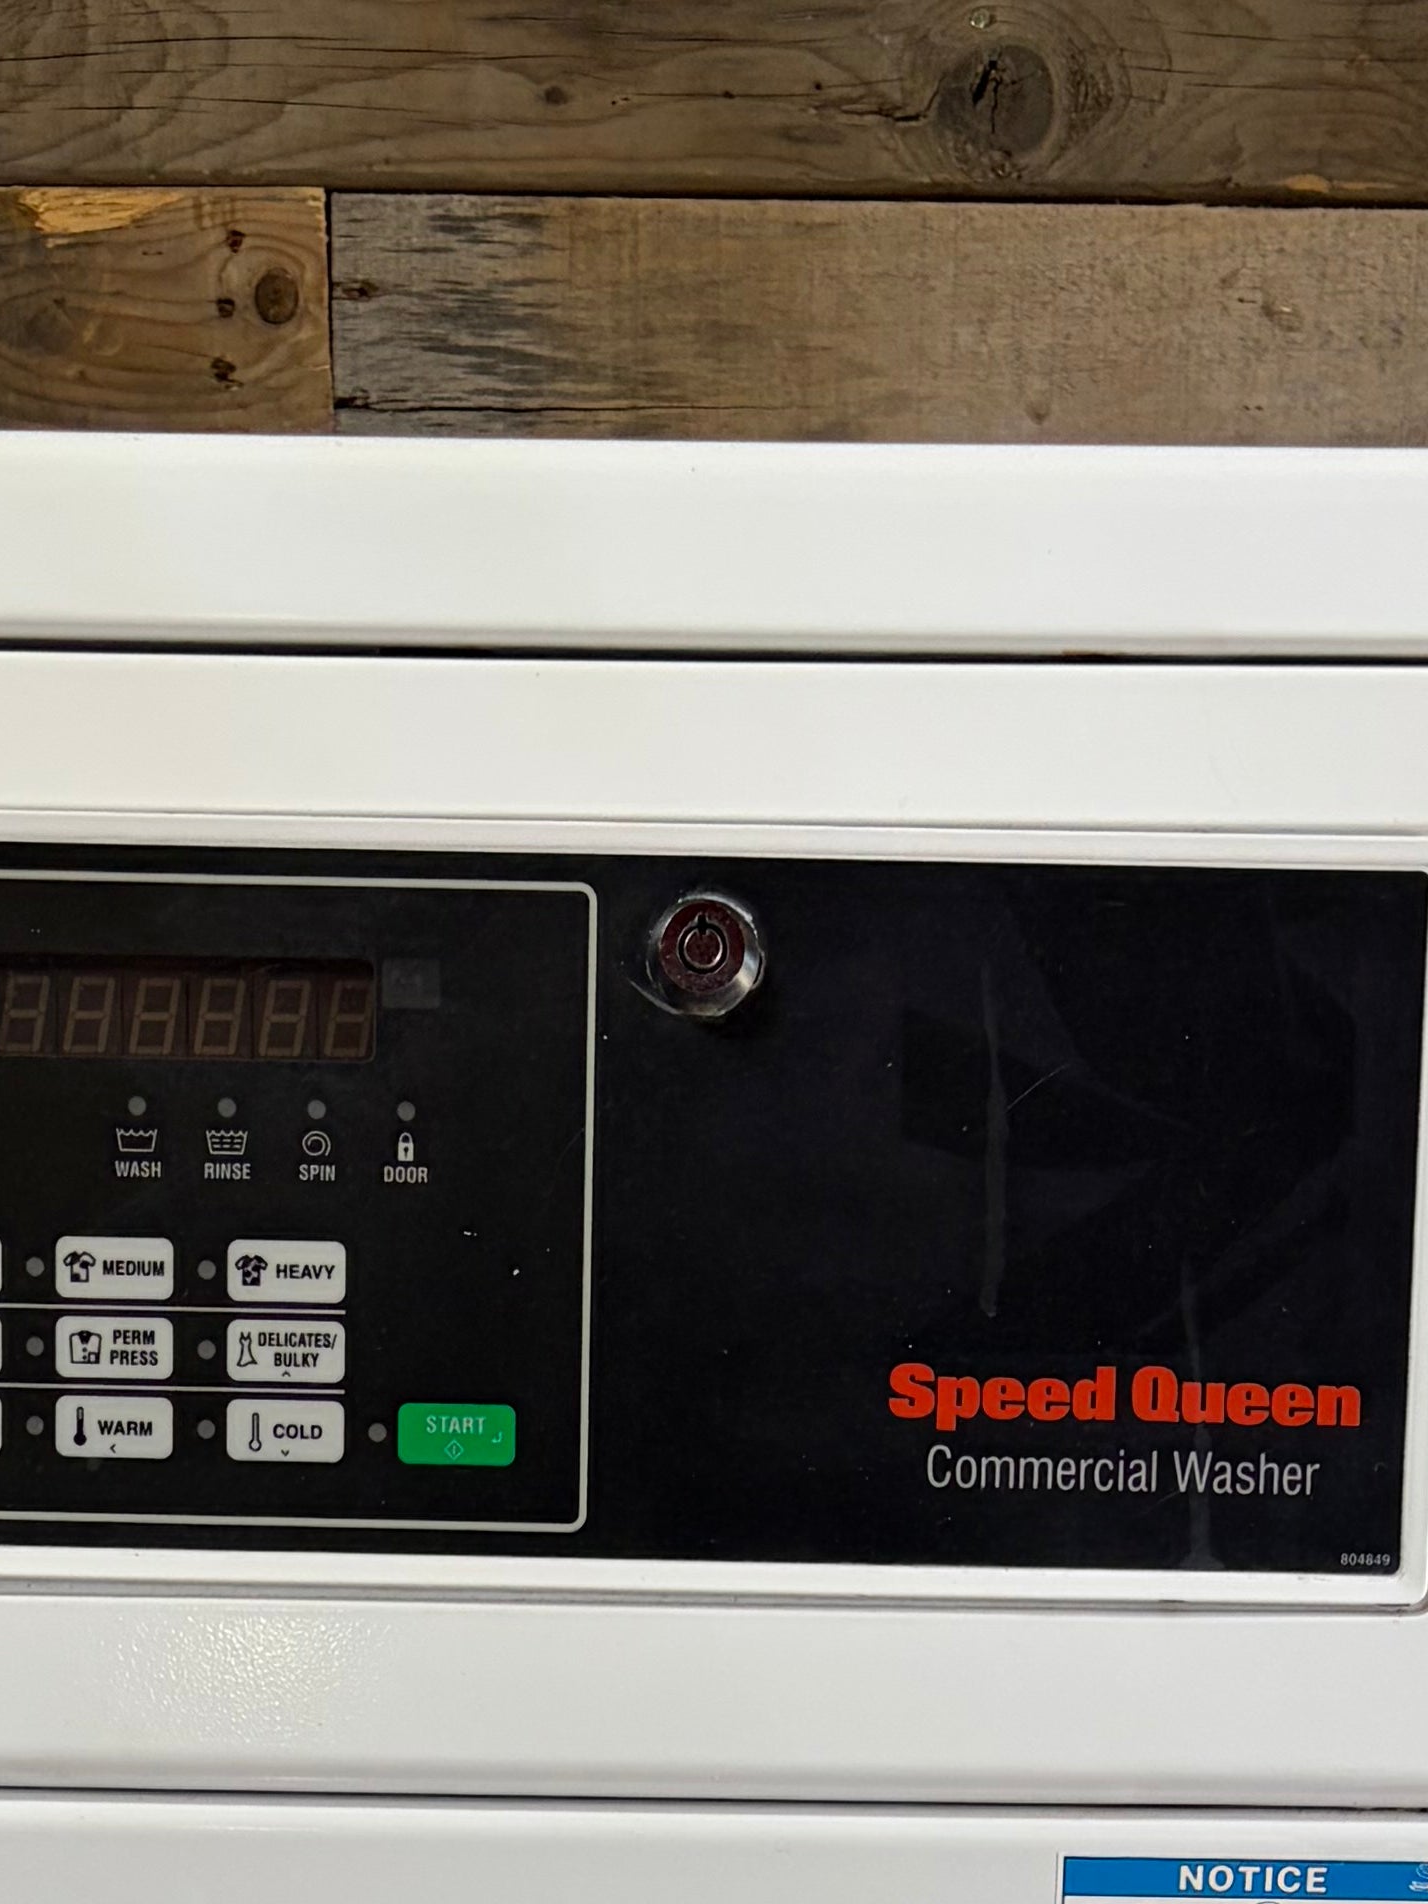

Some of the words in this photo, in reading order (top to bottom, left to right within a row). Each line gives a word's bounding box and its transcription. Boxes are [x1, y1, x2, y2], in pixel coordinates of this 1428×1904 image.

[114, 1160, 162, 1178] WASH
[204, 1162, 251, 1180] RINSE
[298, 1163, 336, 1182] SPIN
[383, 1166, 428, 1184] DOOR
[102, 1259, 165, 1277] MEDIUM
[275, 1263, 336, 1280] HEAVY
[112, 1329, 156, 1346] PERM
[257, 1331, 338, 1350] DELICATES/
[109, 1349, 159, 1367] PRESS
[273, 1351, 320, 1368] BULKY
[888, 1362, 1117, 1432] Speed
[1131, 1365, 1361, 1427] Queen
[97, 1419, 153, 1437] WARM
[272, 1423, 323, 1440] COLD
[426, 1416, 486, 1436] START
[927, 1444, 1158, 1493] Commercial
[1173, 1450, 1321, 1496] Washer
[1340, 1552, 1391, 1567] 804849
[1179, 1865, 1328, 1893] NOTICE
